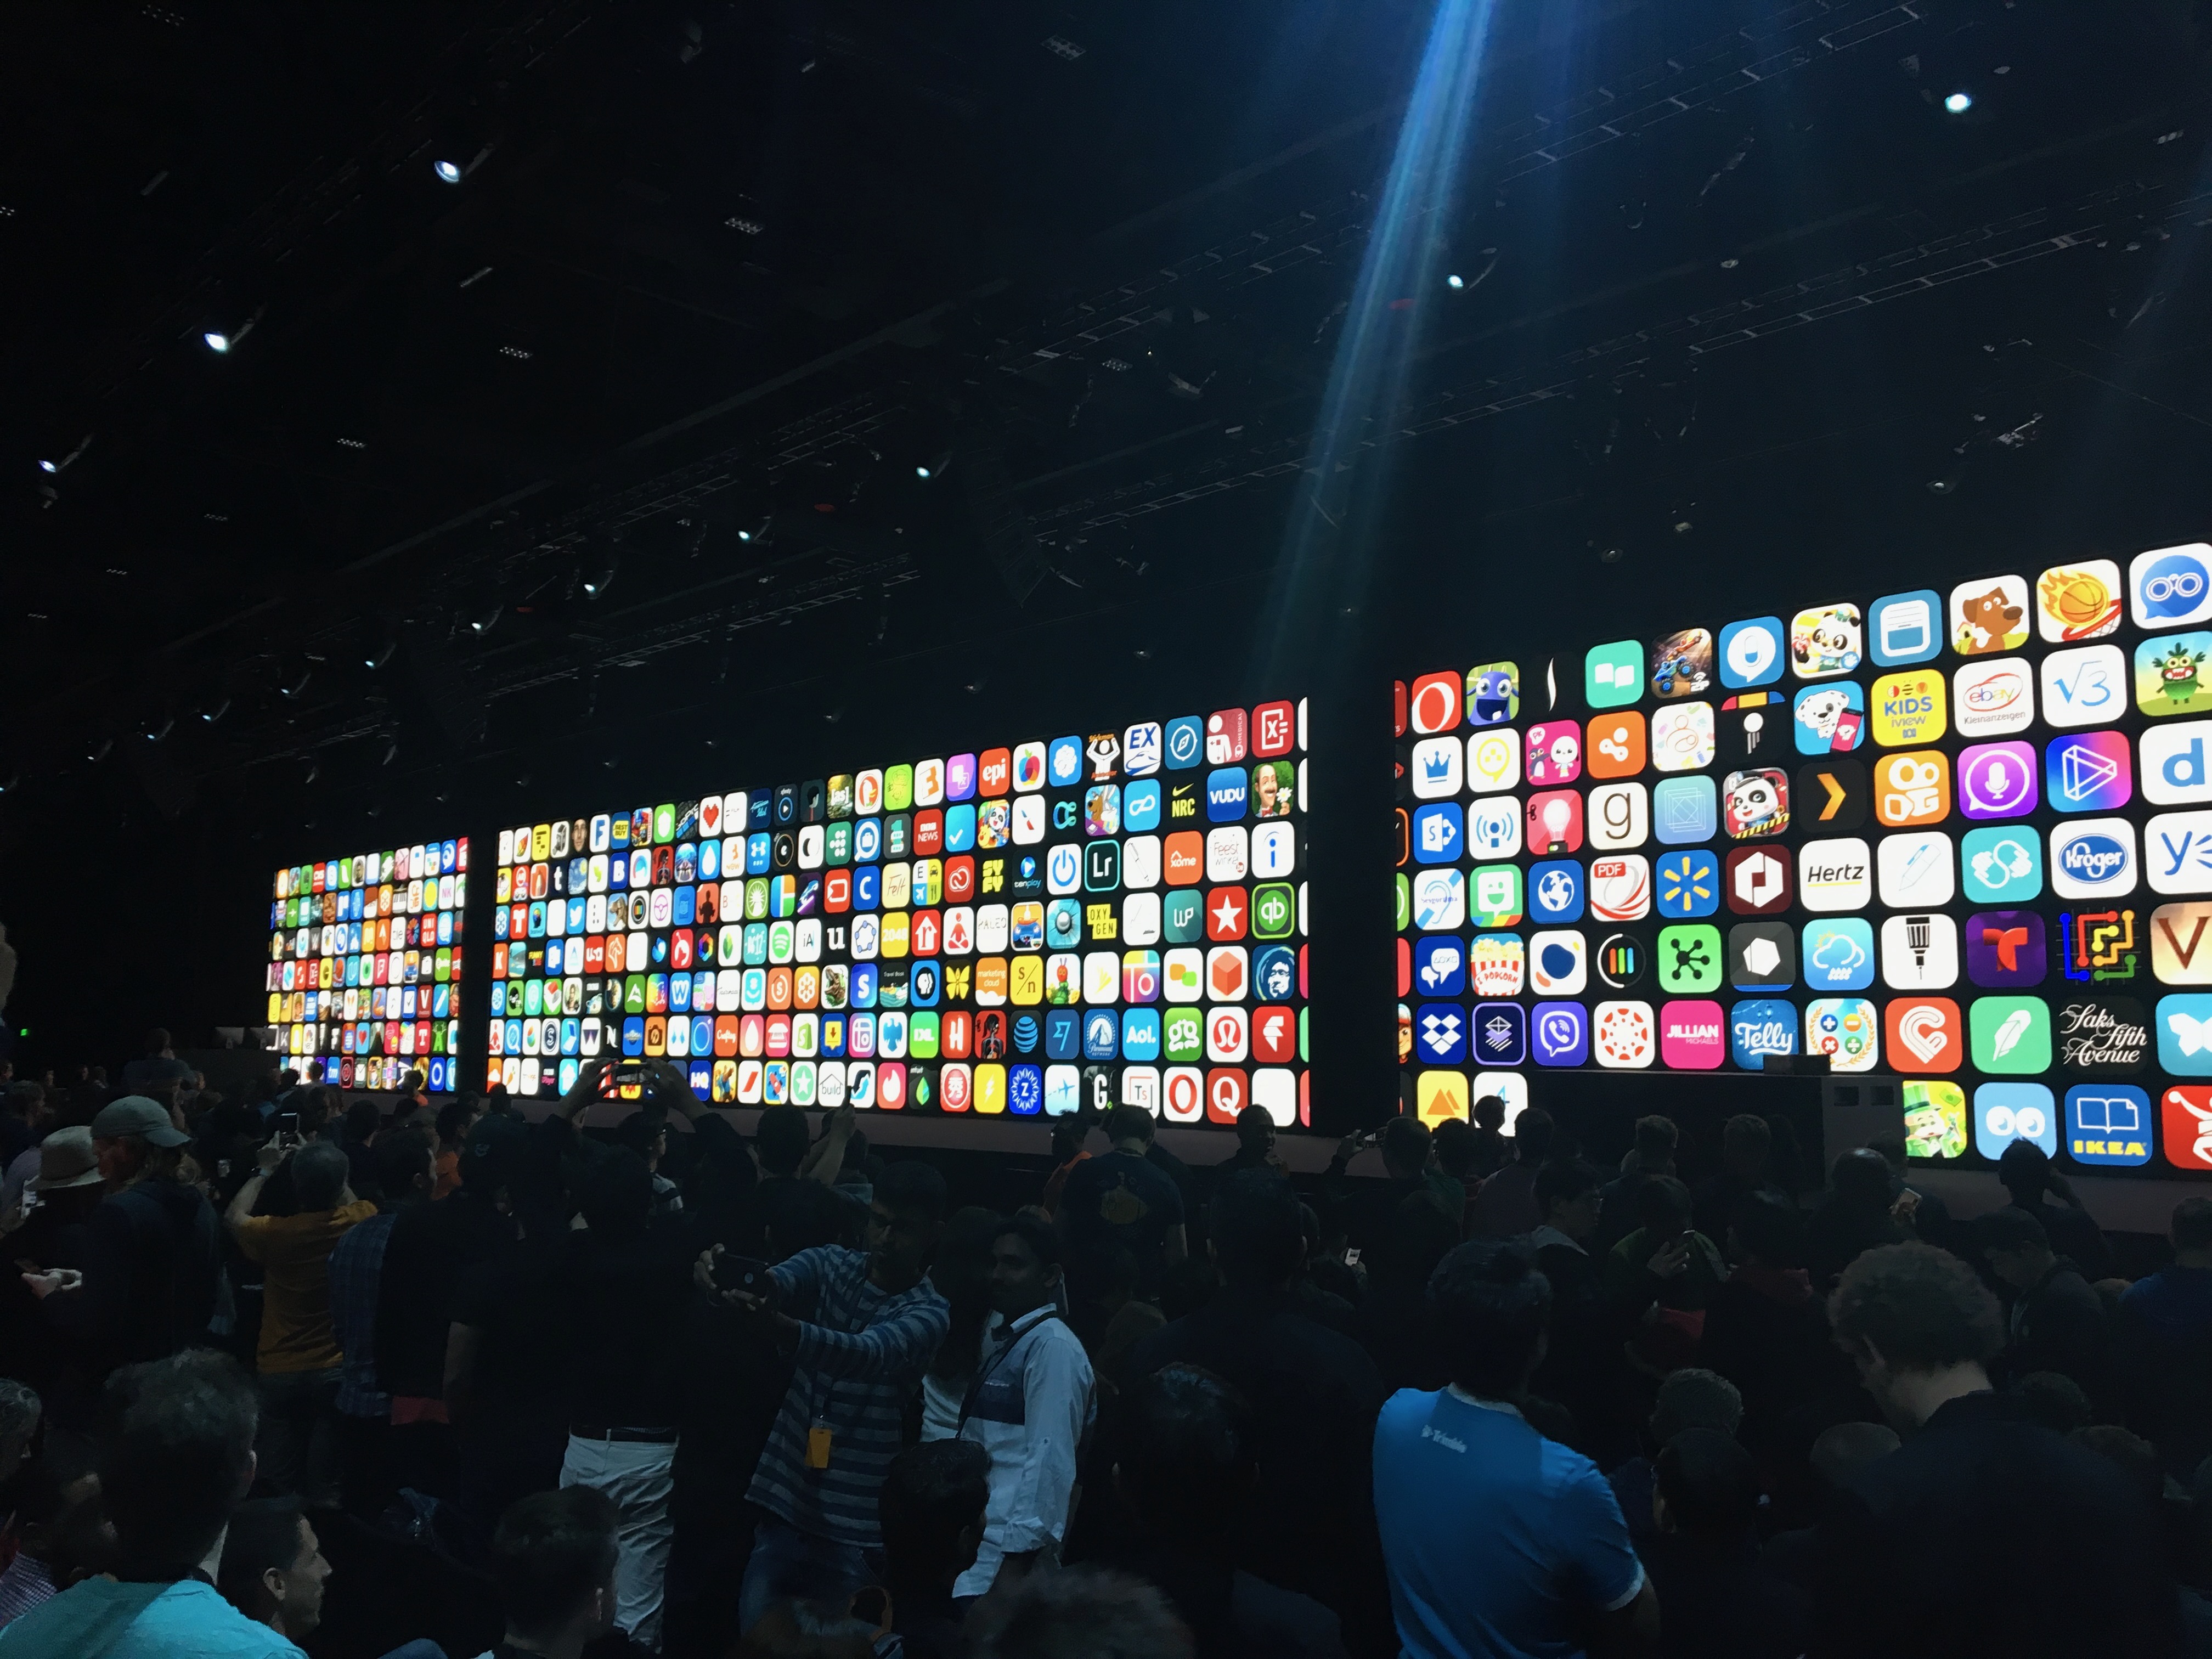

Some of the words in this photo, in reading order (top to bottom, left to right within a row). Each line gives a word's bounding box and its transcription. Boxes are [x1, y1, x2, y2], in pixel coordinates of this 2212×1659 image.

[1969, 684, 2015, 703] ebay
[1884, 696, 1933, 716] KIDS
[1891, 715, 1927, 728] iview
[1964, 710, 2026, 725] Kleinanzeigen
[1129, 725, 1158, 750] EX
[2162, 737, 2205, 787] d
[983, 758, 1006, 786] epi
[1210, 787, 1245, 805] VUDU
[1172, 798, 1195, 818] NRC
[1604, 792, 1632, 839] g
[917, 831, 938, 843] NEWS
[1093, 852, 1112, 878] Lr
[1598, 862, 1623, 876] PDF
[2066, 842, 2123, 878] Kroger
[1808, 864, 1865, 882] Hertz
[887, 873, 906, 897] Felt
[1090, 908, 1108, 921] OXY
[882, 927, 909, 943] 2048
[1096, 922, 1114, 935] GEN
[827, 927, 845, 950] u
[978, 969, 1006, 979] marketing
[984, 979, 1000, 988] cloud
[1485, 971, 1519, 984] POPCORN
[2059, 1003, 2115, 1035] Saks
[913, 1028, 935, 1041] IXL
[1667, 1025, 1719, 1038] JILLIAN
[1735, 1022, 1793, 1054] Telly
[2091, 1022, 2147, 1050] Fifth
[2061, 1037, 2140, 1066] Avenue
[690, 1071, 709, 1090] HQ
[822, 1084, 842, 1096] build
[1212, 1076, 1242, 1117] Q
[2074, 1140, 2147, 1156] IKEA
